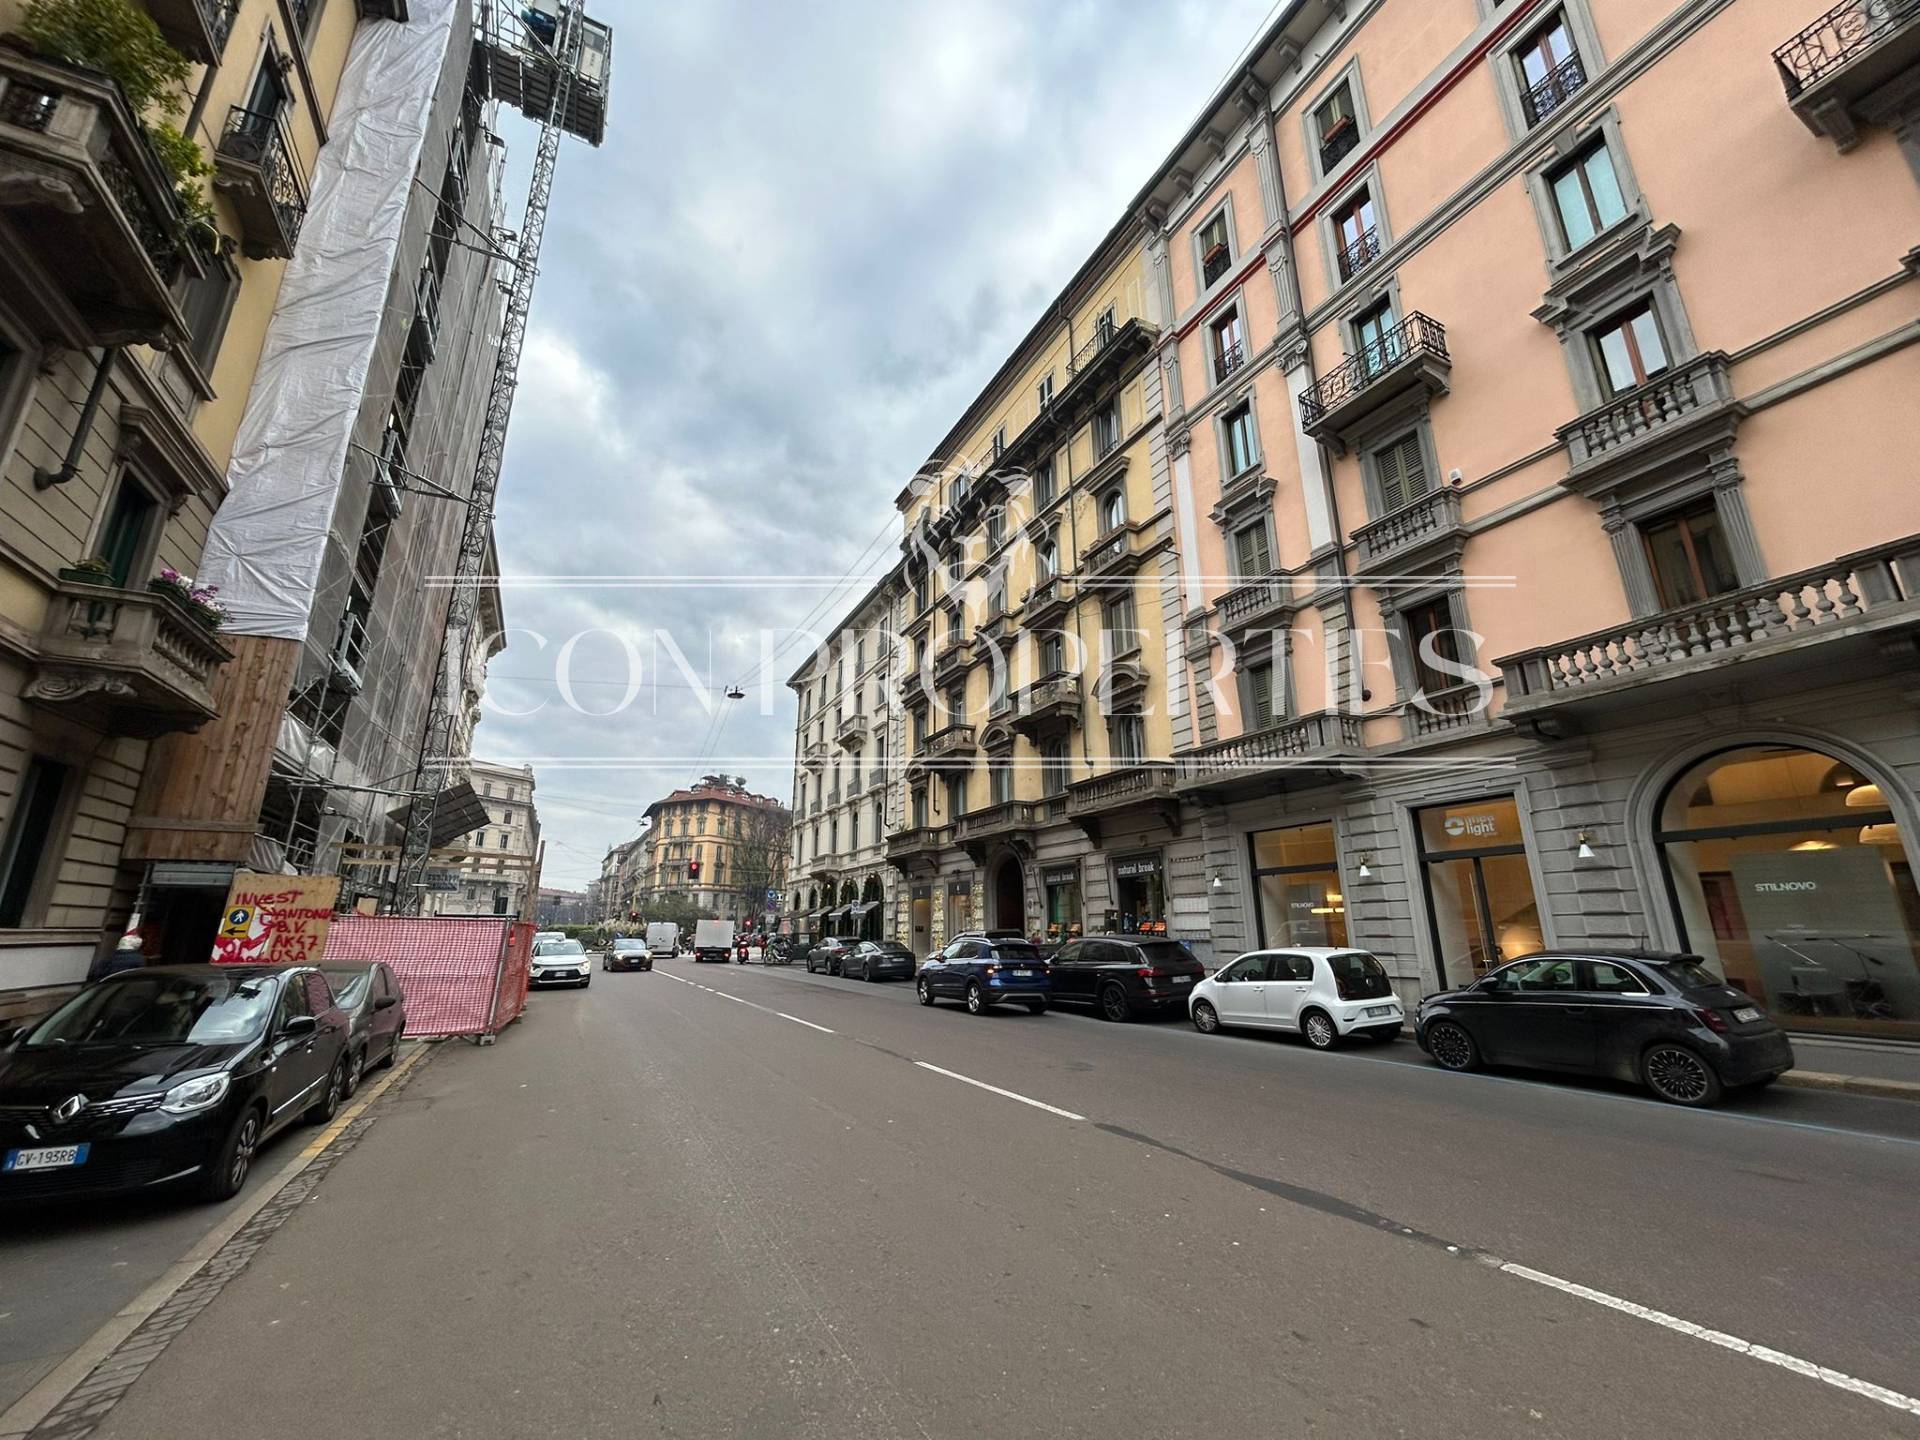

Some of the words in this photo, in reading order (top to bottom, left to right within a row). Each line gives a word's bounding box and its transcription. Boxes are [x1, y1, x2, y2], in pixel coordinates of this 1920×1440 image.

[1465, 822, 1495, 836] light
[1118, 863, 1137, 875] natural
[1138, 861, 1155, 874] break
[1755, 881, 1817, 892] STILNOVO
[235, 889, 304, 906] INVEST
[270, 949, 308, 963] USA
